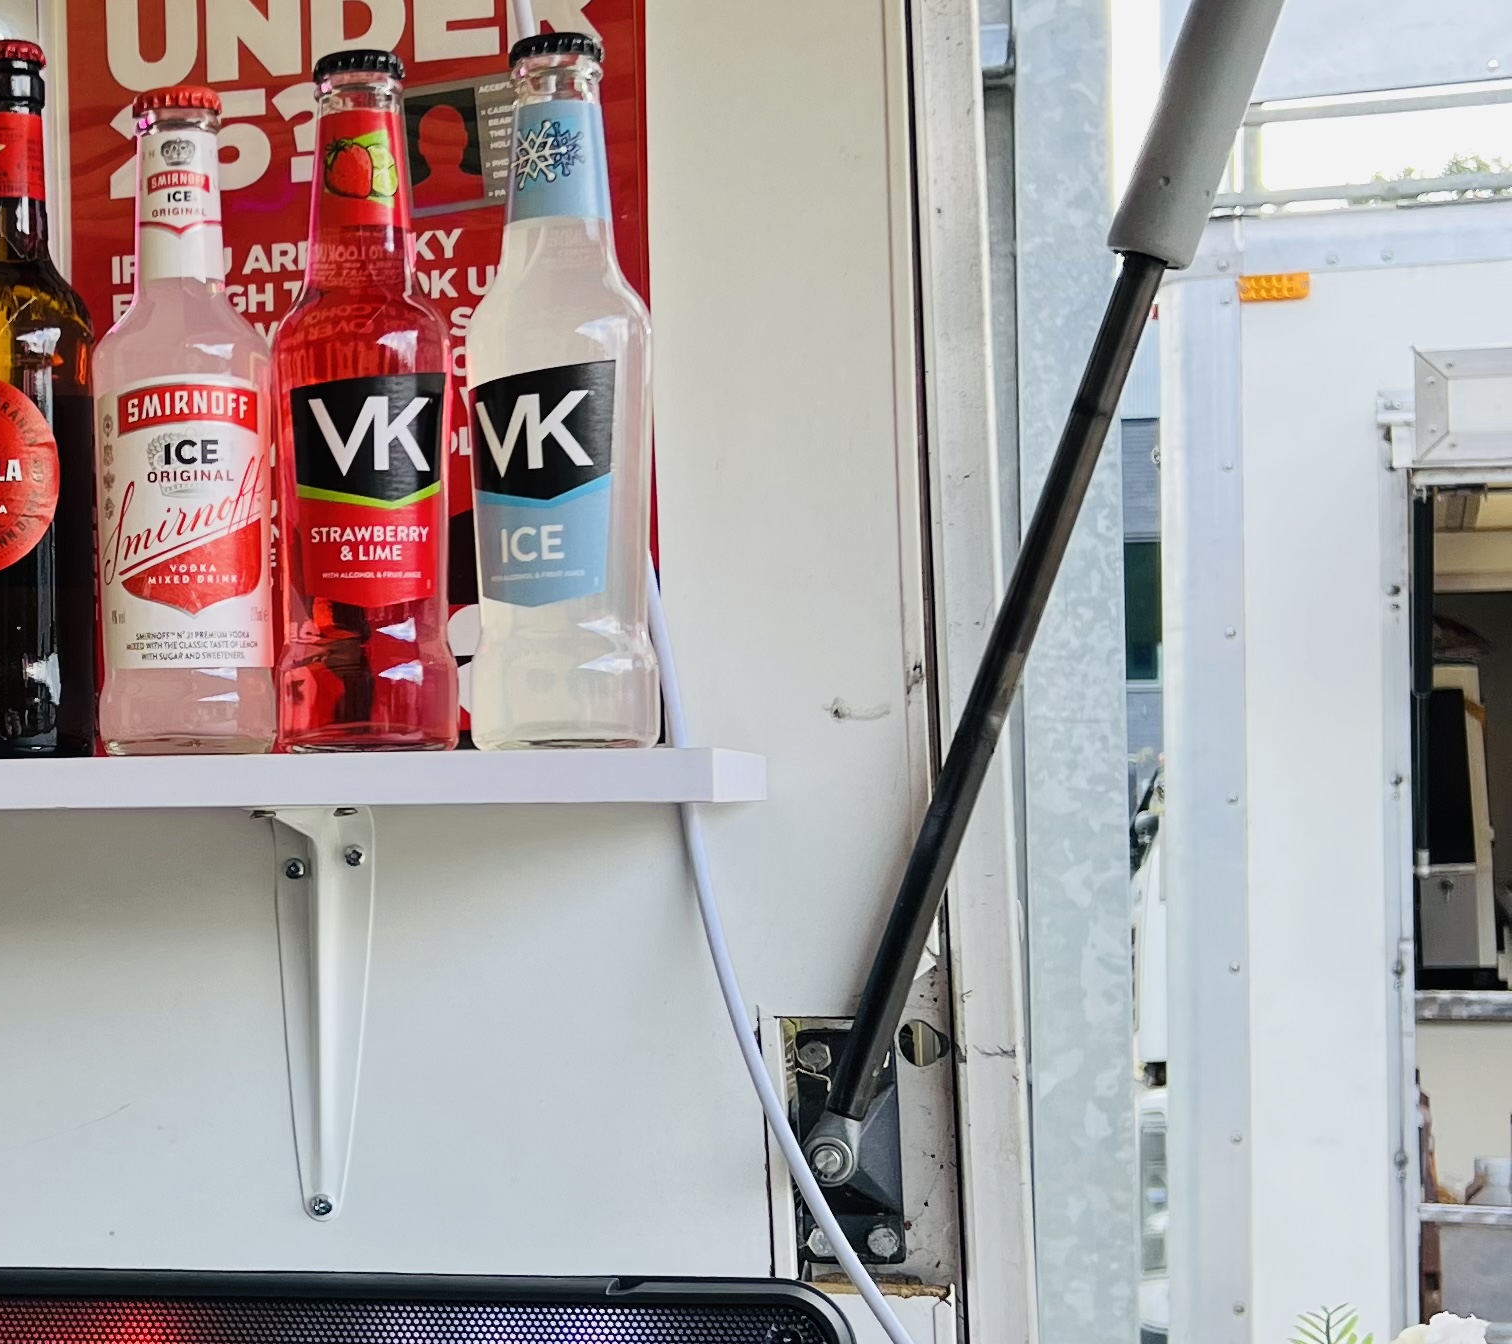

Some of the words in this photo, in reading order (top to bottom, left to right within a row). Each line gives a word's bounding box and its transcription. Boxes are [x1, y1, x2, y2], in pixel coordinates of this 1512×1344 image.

[150, 172, 206, 190] SMIRNOFF
[167, 190, 193, 203] ICE
[127, 389, 249, 423] SMIRNOFF
[308, 396, 431, 477] VK
[475, 389, 594, 479] VK
[164, 439, 219, 465] ICE
[147, 470, 235, 484] ORIGINAL
[104, 454, 265, 587] Smirnoff
[310, 525, 430, 543] STRAWBERRY
[340, 545, 353, 561] &
[358, 544, 403, 561] LIME
[501, 524, 565, 564] ICE
[169, 563, 217, 573] VODKA
[148, 574, 190, 585] MIXED
[197, 574, 238, 585] DRINK
